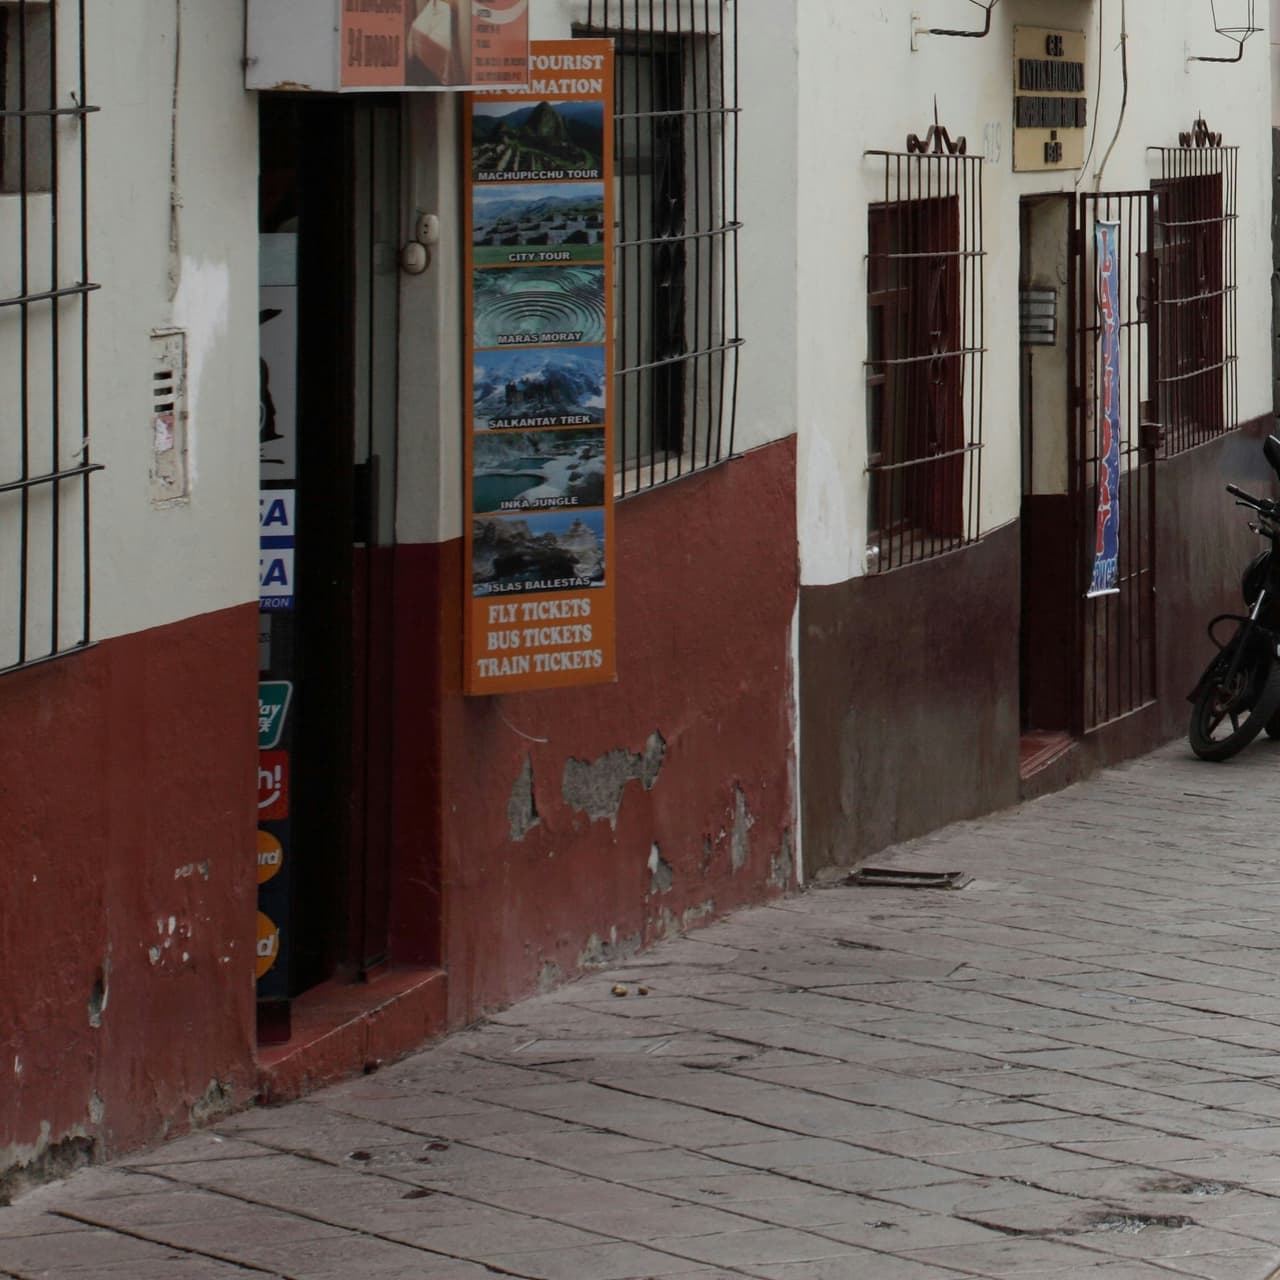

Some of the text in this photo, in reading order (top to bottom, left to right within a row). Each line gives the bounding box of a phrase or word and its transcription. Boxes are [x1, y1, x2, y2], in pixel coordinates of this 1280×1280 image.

[529, 55, 604, 70] TOURIST
[478, 170, 598, 181] MACHUPICCHU TOUR
[509, 252, 570, 262] CITY TOUR
[498, 332, 582, 344] MARAS MORAY
[488, 415, 590, 429] SALKANTAY TREK
[501, 497, 579, 509] INKA JUNGLE
[488, 577, 591, 593] ISLAS BALLESTAS
[488, 598, 591, 624] FLY TICKETS
[488, 624, 592, 650] BUS TICKETS
[477, 649, 602, 677] TRAIN TICKETS
